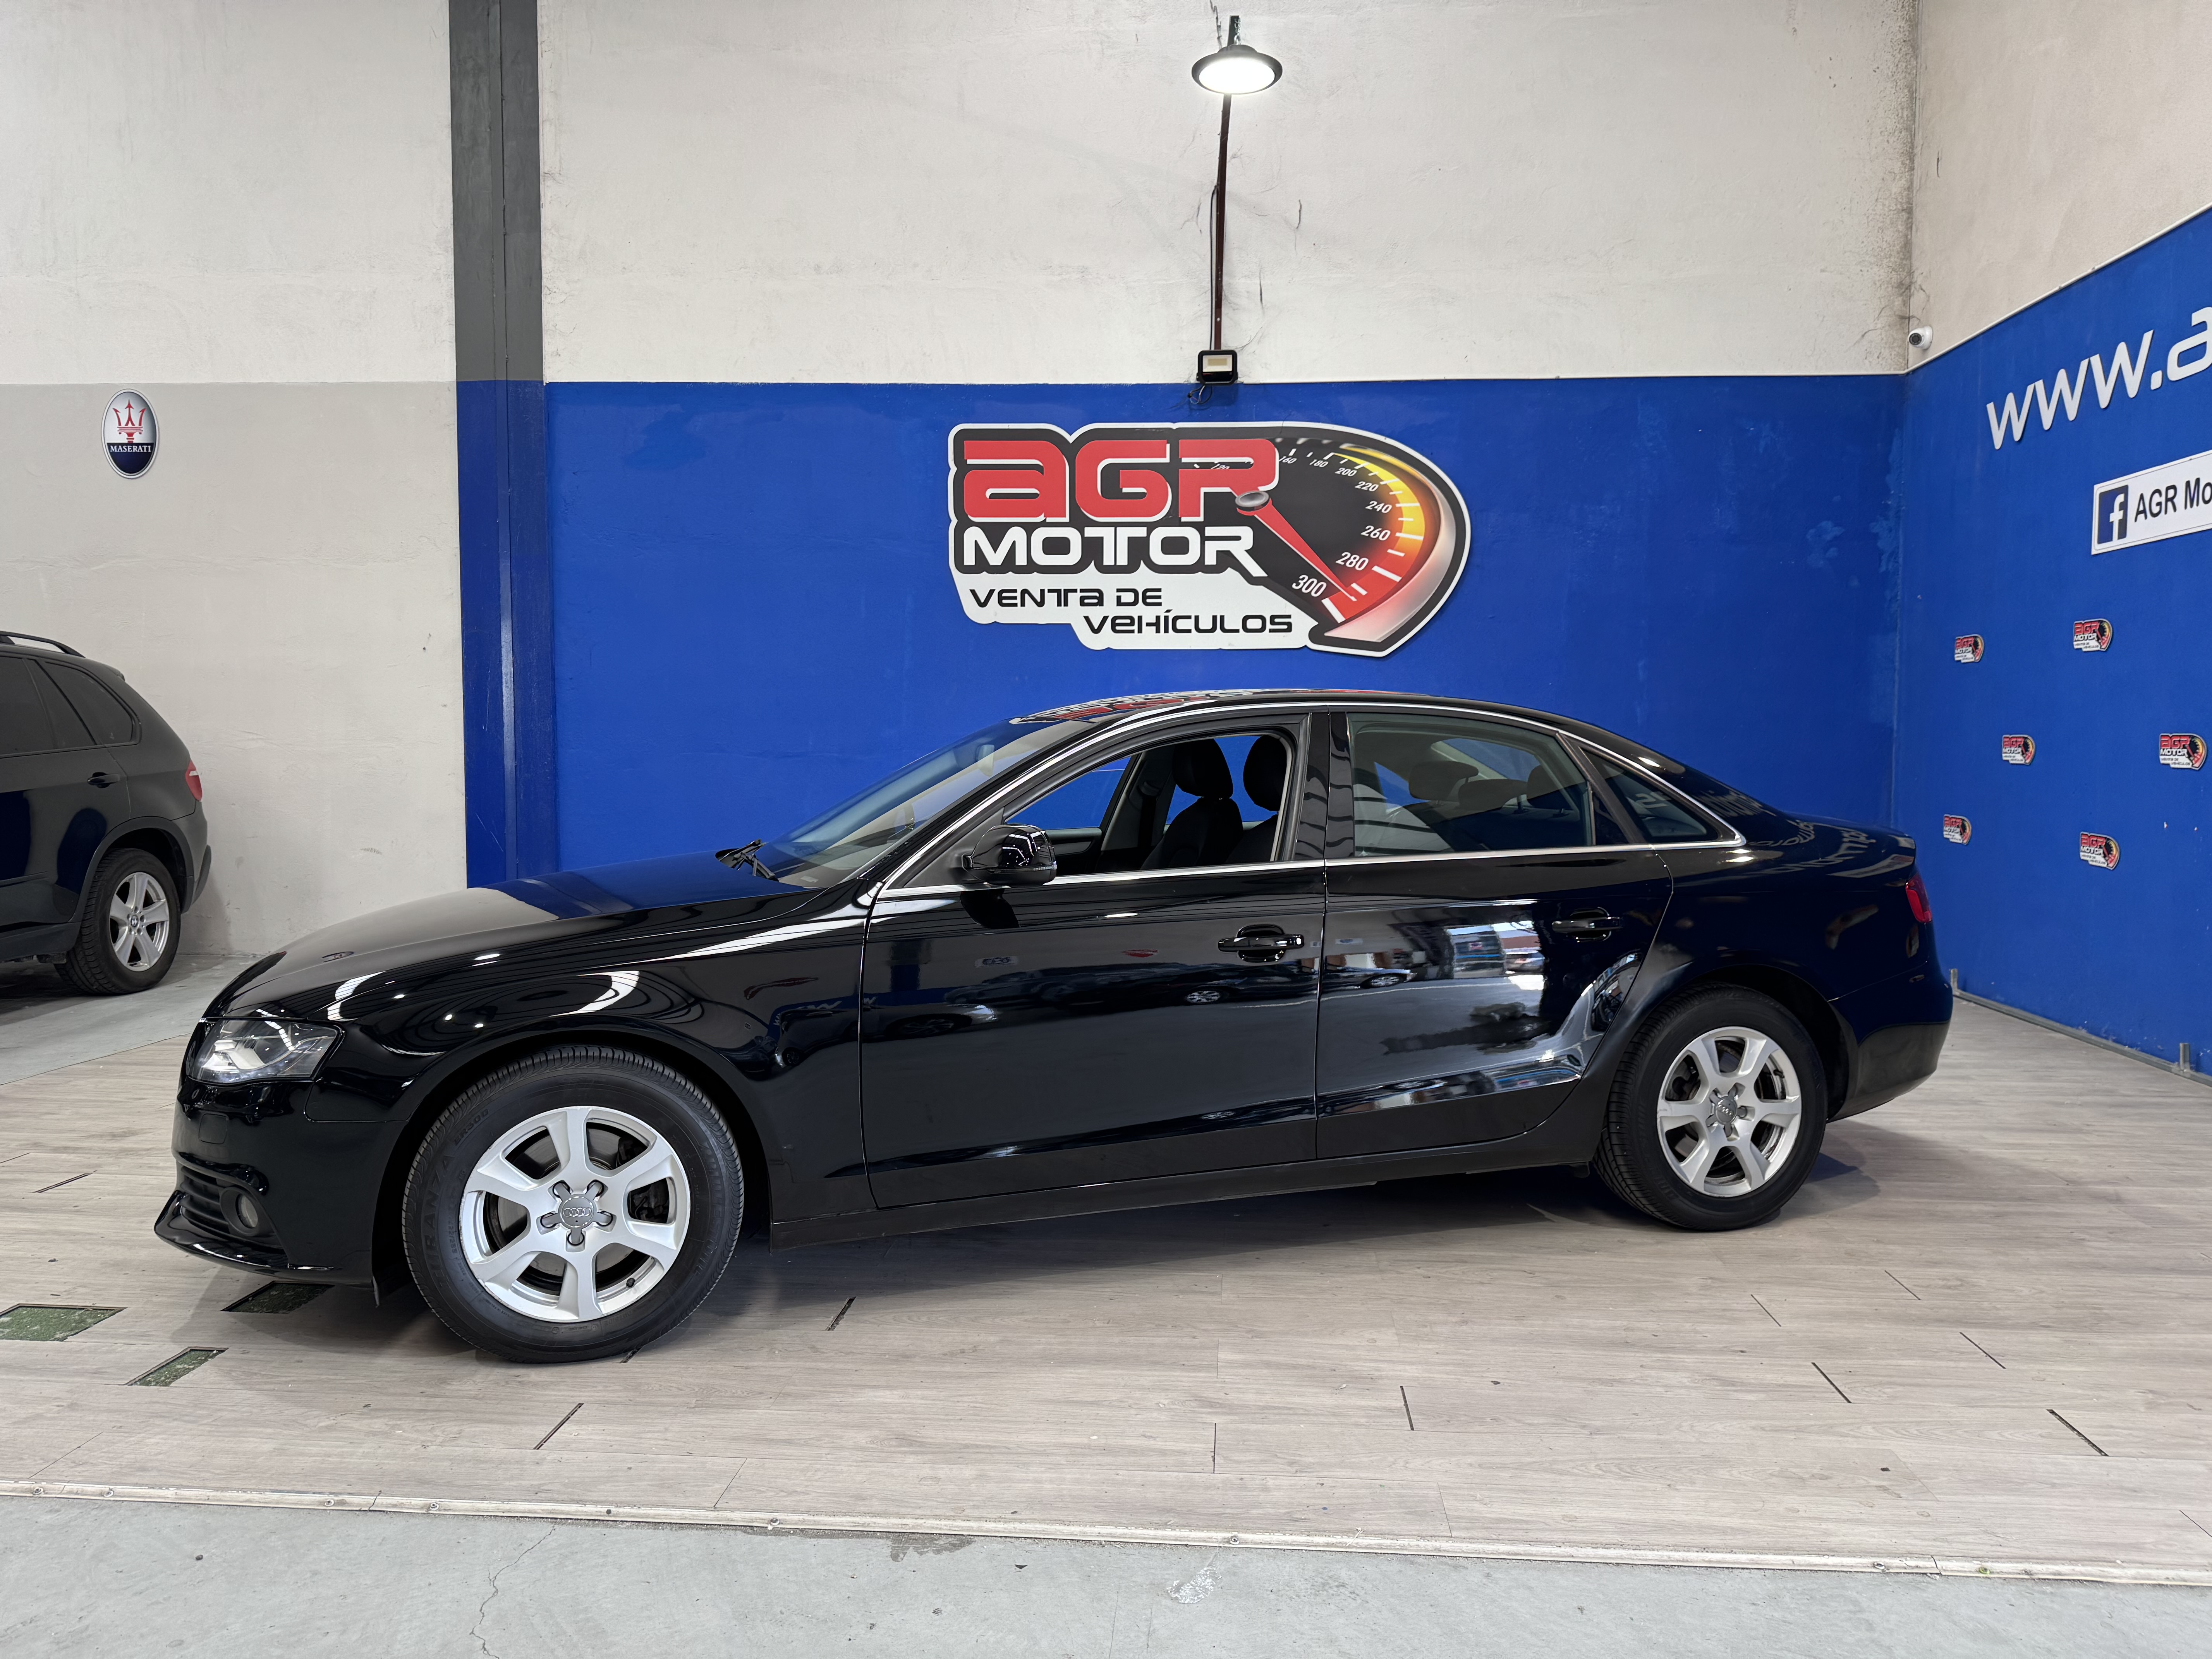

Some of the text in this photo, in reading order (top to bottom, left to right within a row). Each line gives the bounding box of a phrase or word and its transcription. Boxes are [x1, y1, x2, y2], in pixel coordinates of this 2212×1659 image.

[1279, 456, 1297, 464] 160
[1309, 459, 1329, 468] 180
[1335, 467, 1357, 477] 200
[1355, 481, 1379, 492] 220
[1365, 501, 1392, 514] 240
[2135, 484, 2177, 522] AGR
[1361, 526, 1391, 541] 260
[963, 526, 1268, 577] MOTOR
[1335, 552, 1369, 571] 280
[1292, 575, 1327, 597] 300
[1117, 588, 1162, 607] DE
[2160, 749, 2188, 757] MOTOR
